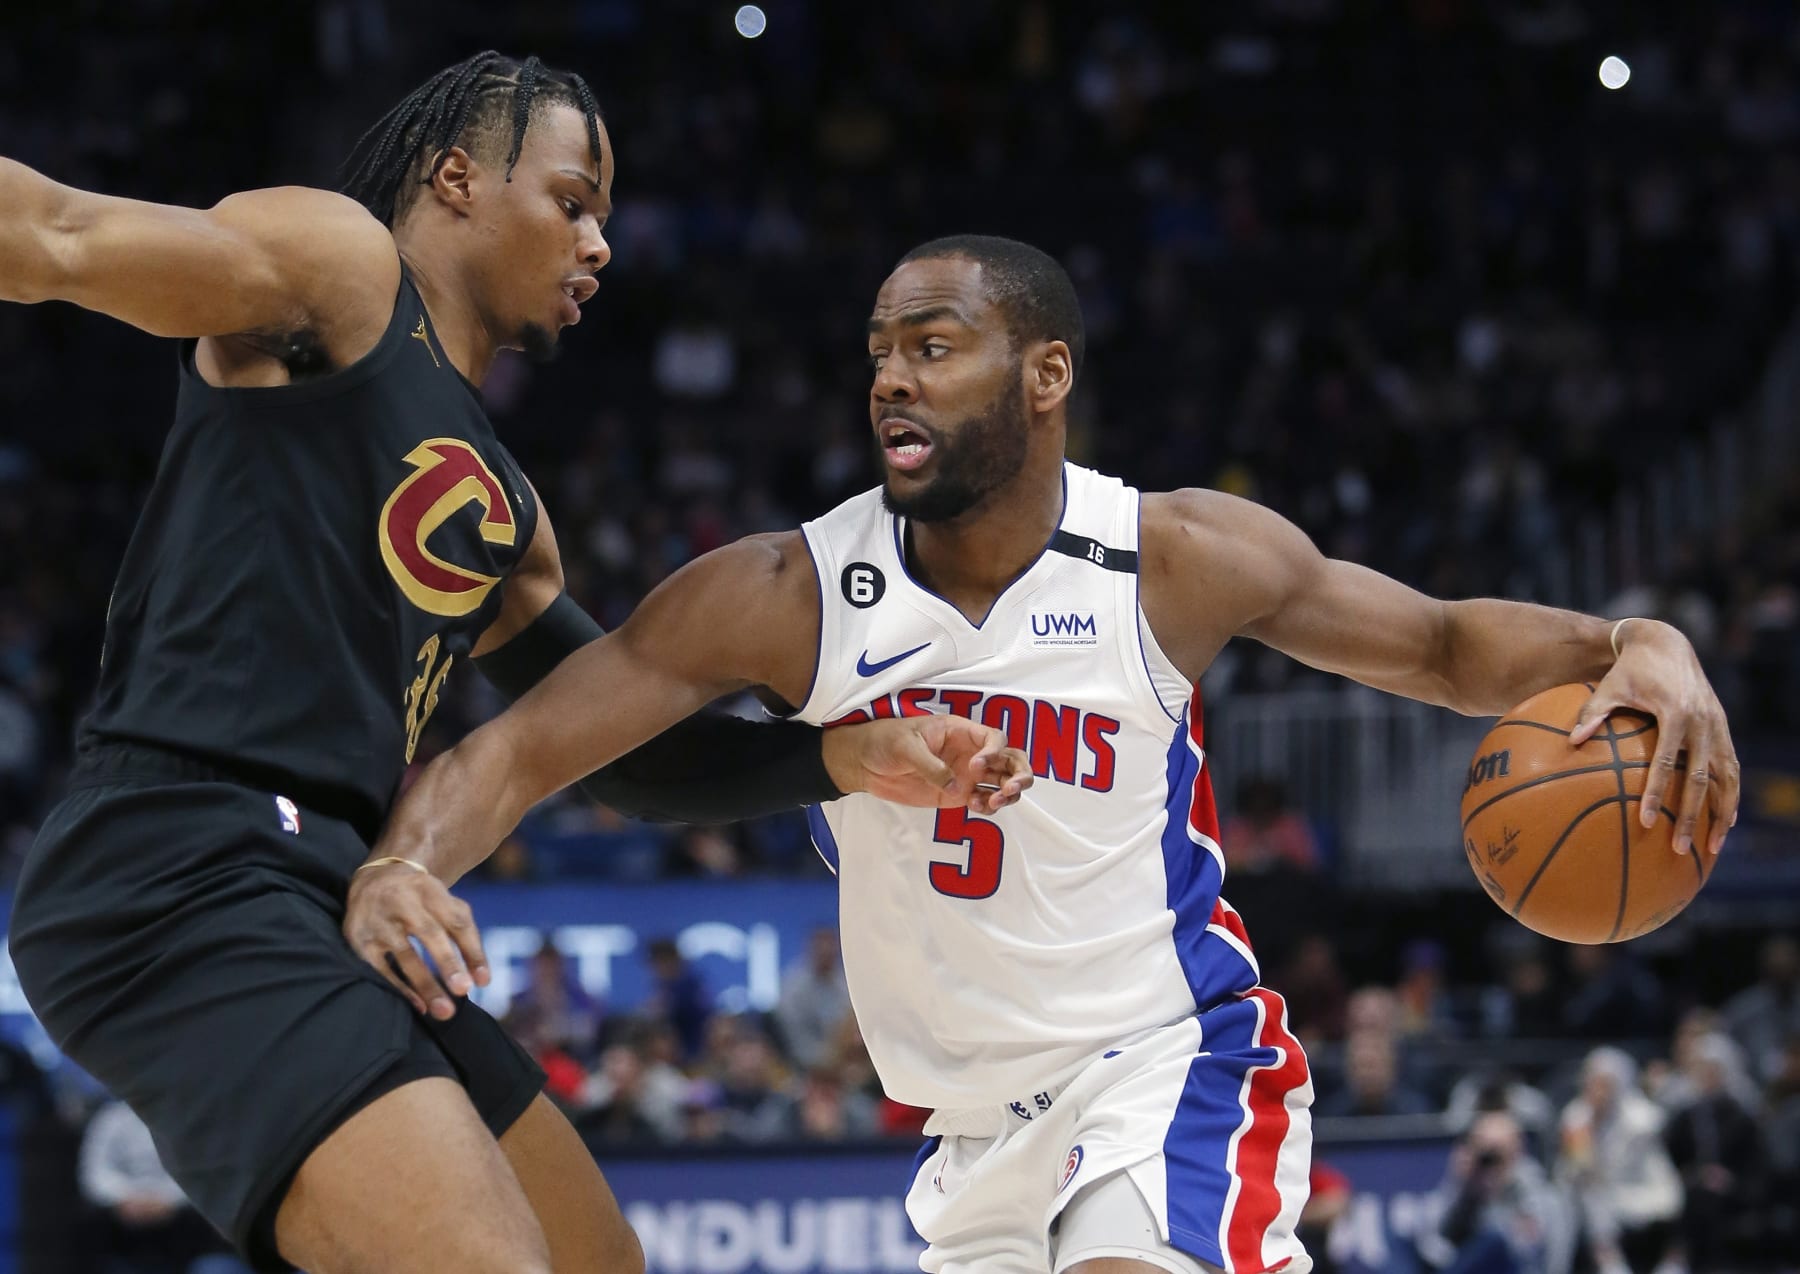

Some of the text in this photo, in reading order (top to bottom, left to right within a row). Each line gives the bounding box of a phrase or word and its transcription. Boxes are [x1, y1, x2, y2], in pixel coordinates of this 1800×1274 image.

[1087, 542, 1105, 564] 16
[851, 569, 873, 602] 6
[1031, 613, 1097, 636] UWM
[822, 687, 1120, 793] TONS
[928, 805, 1004, 900] 5
